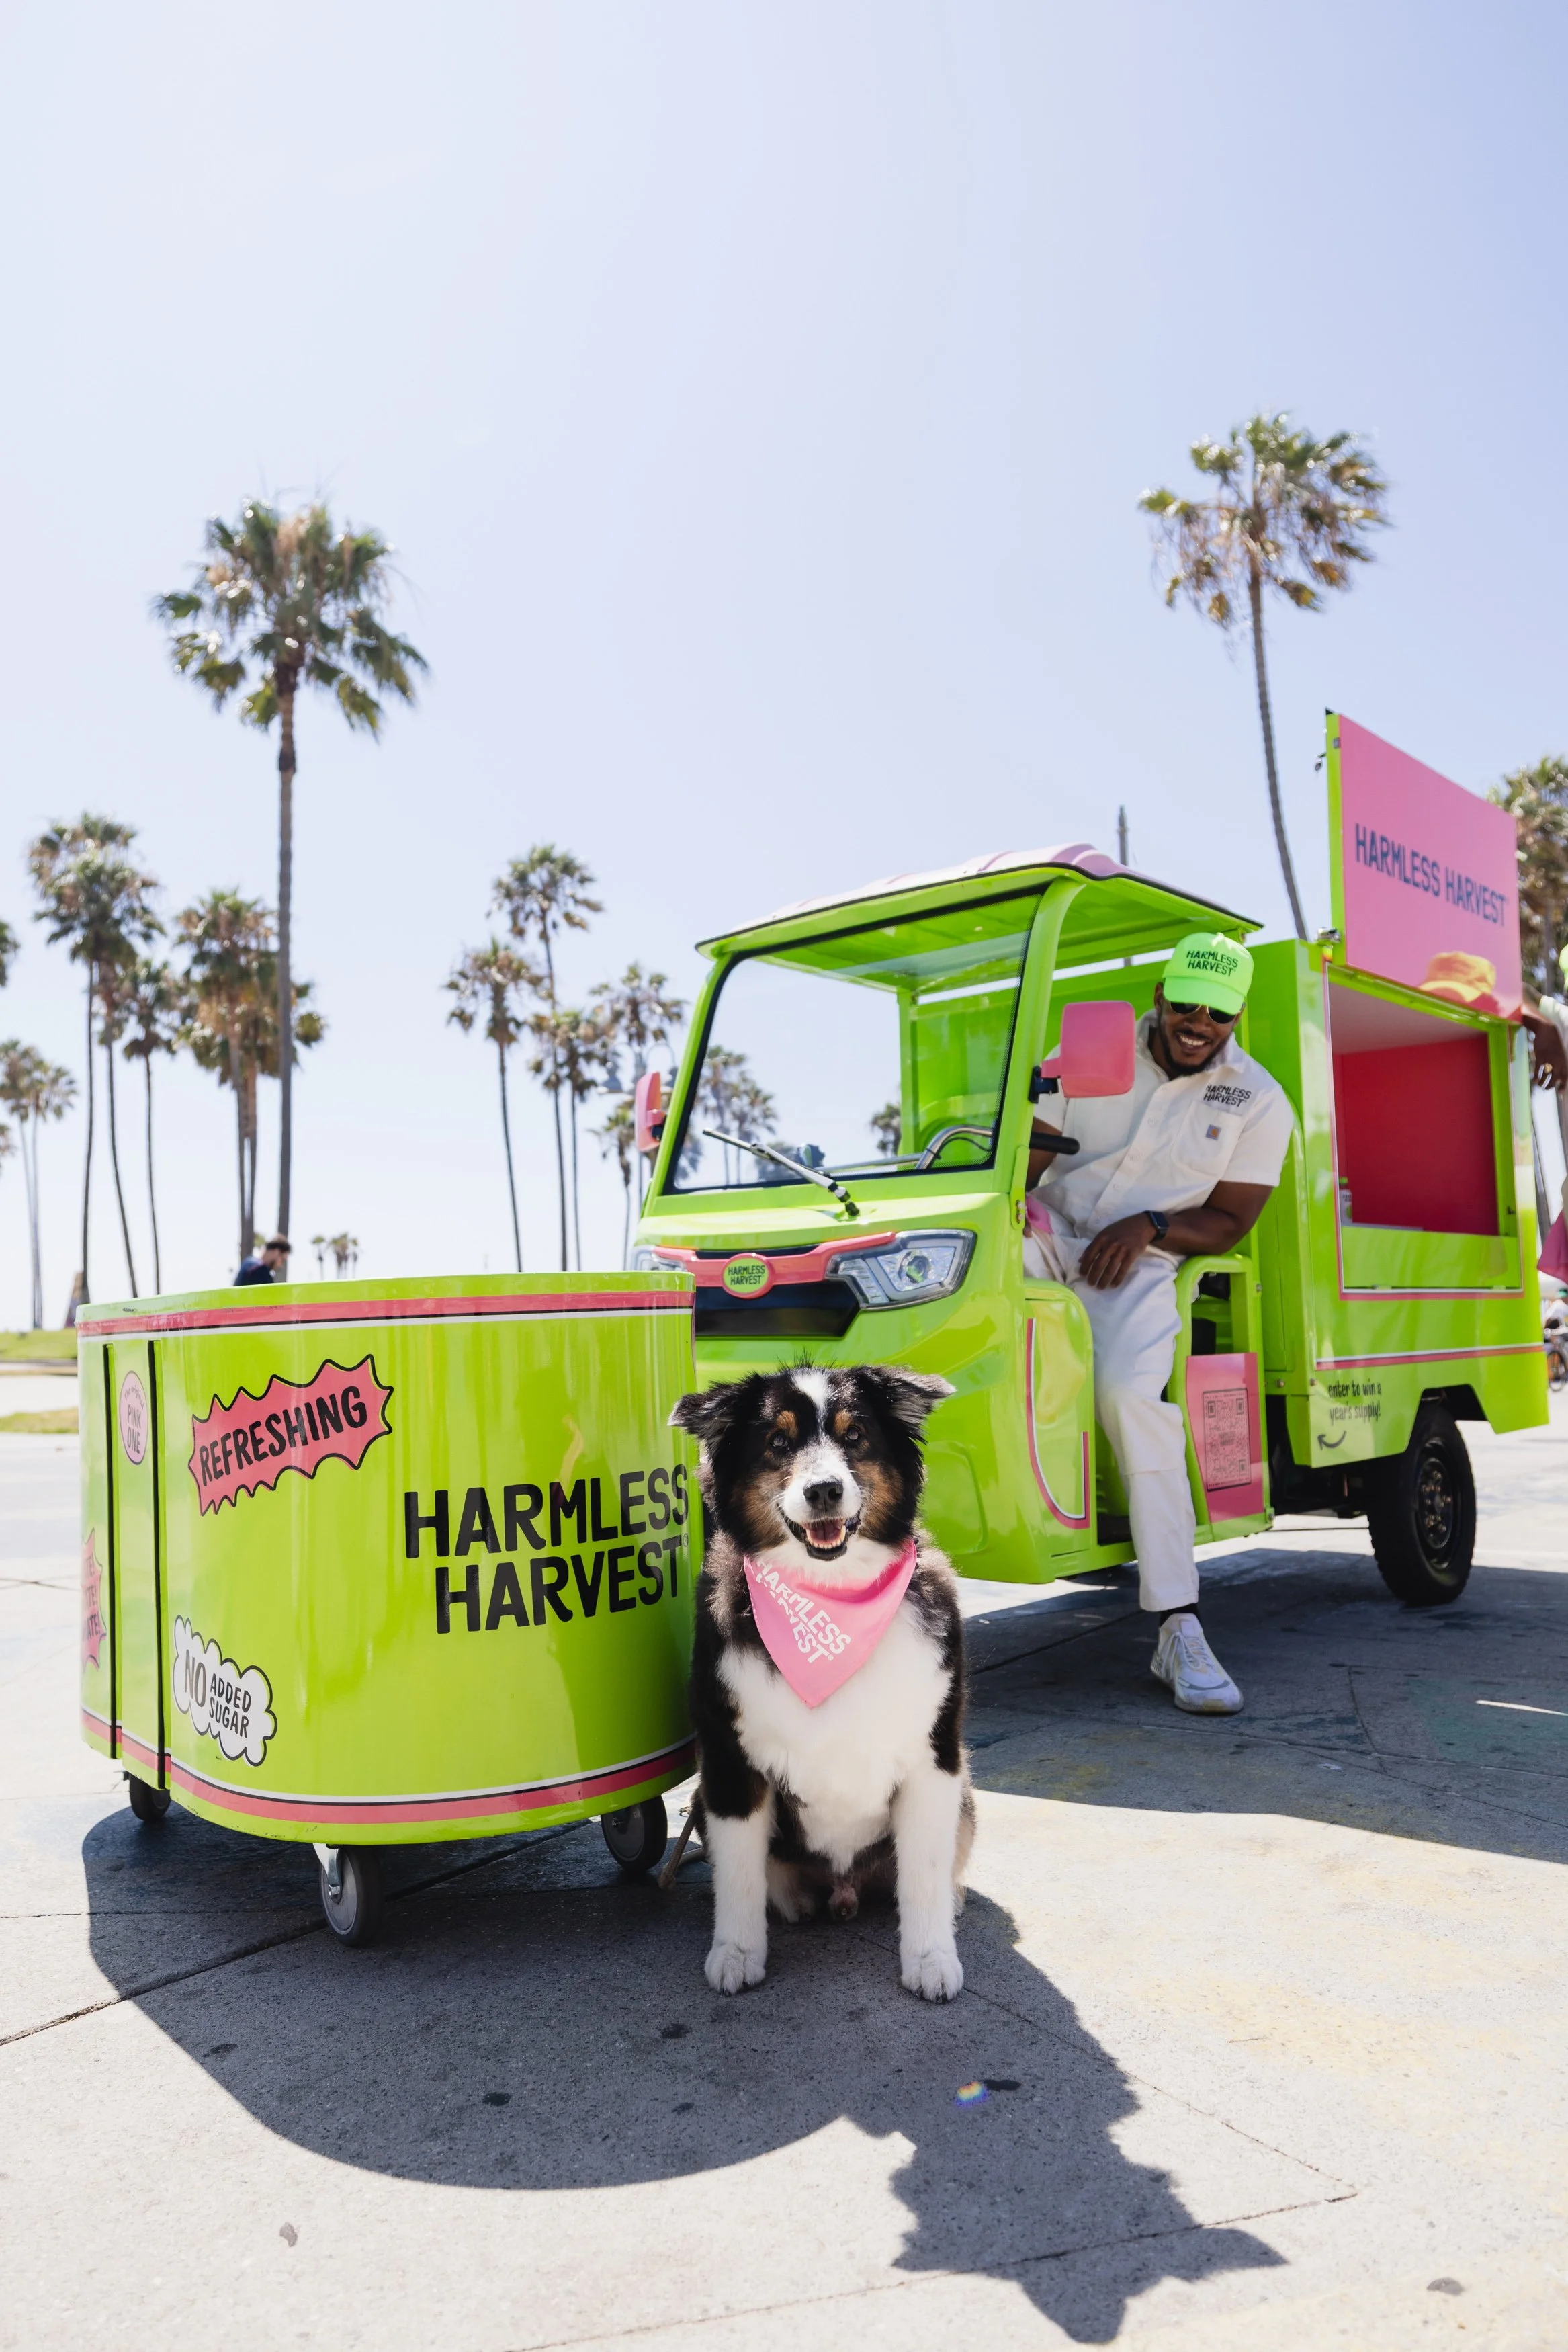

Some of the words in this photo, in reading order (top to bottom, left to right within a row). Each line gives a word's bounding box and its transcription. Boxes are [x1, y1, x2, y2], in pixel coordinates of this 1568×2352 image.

[1354, 821, 1441, 897] HARMLESS
[1446, 866, 1506, 927] HARVEST
[1186, 950, 1238, 968] HARMLESS
[1187, 959, 1234, 976] HARVEST
[1203, 1092, 1245, 1107] HARVEST
[1206, 1084, 1252, 1099] HARMLESS
[728, 1265, 765, 1275] HARMLESS
[730, 1275, 762, 1285] HARVEST
[1328, 1381, 1350, 1397] enter
[1352, 1380, 1360, 1396] to
[1362, 1378, 1376, 1396] win
[1377, 1382, 1382, 1395] a
[127, 1404, 141, 1429] PINK
[1330, 1401, 1352, 1426] year's
[1354, 1400, 1381, 1423] supply!
[127, 1426, 140, 1454] ONE
[198, 1386, 367, 1487] REFRESHING
[404, 1464, 689, 1558] HARMLESS
[756, 1560, 851, 1655] HARMLESS
[756, 1572, 830, 1663] VEST
[184, 1649, 206, 1708] NO
[210, 1673, 251, 1713] ADDED
[209, 1696, 249, 1738] SUGAR
